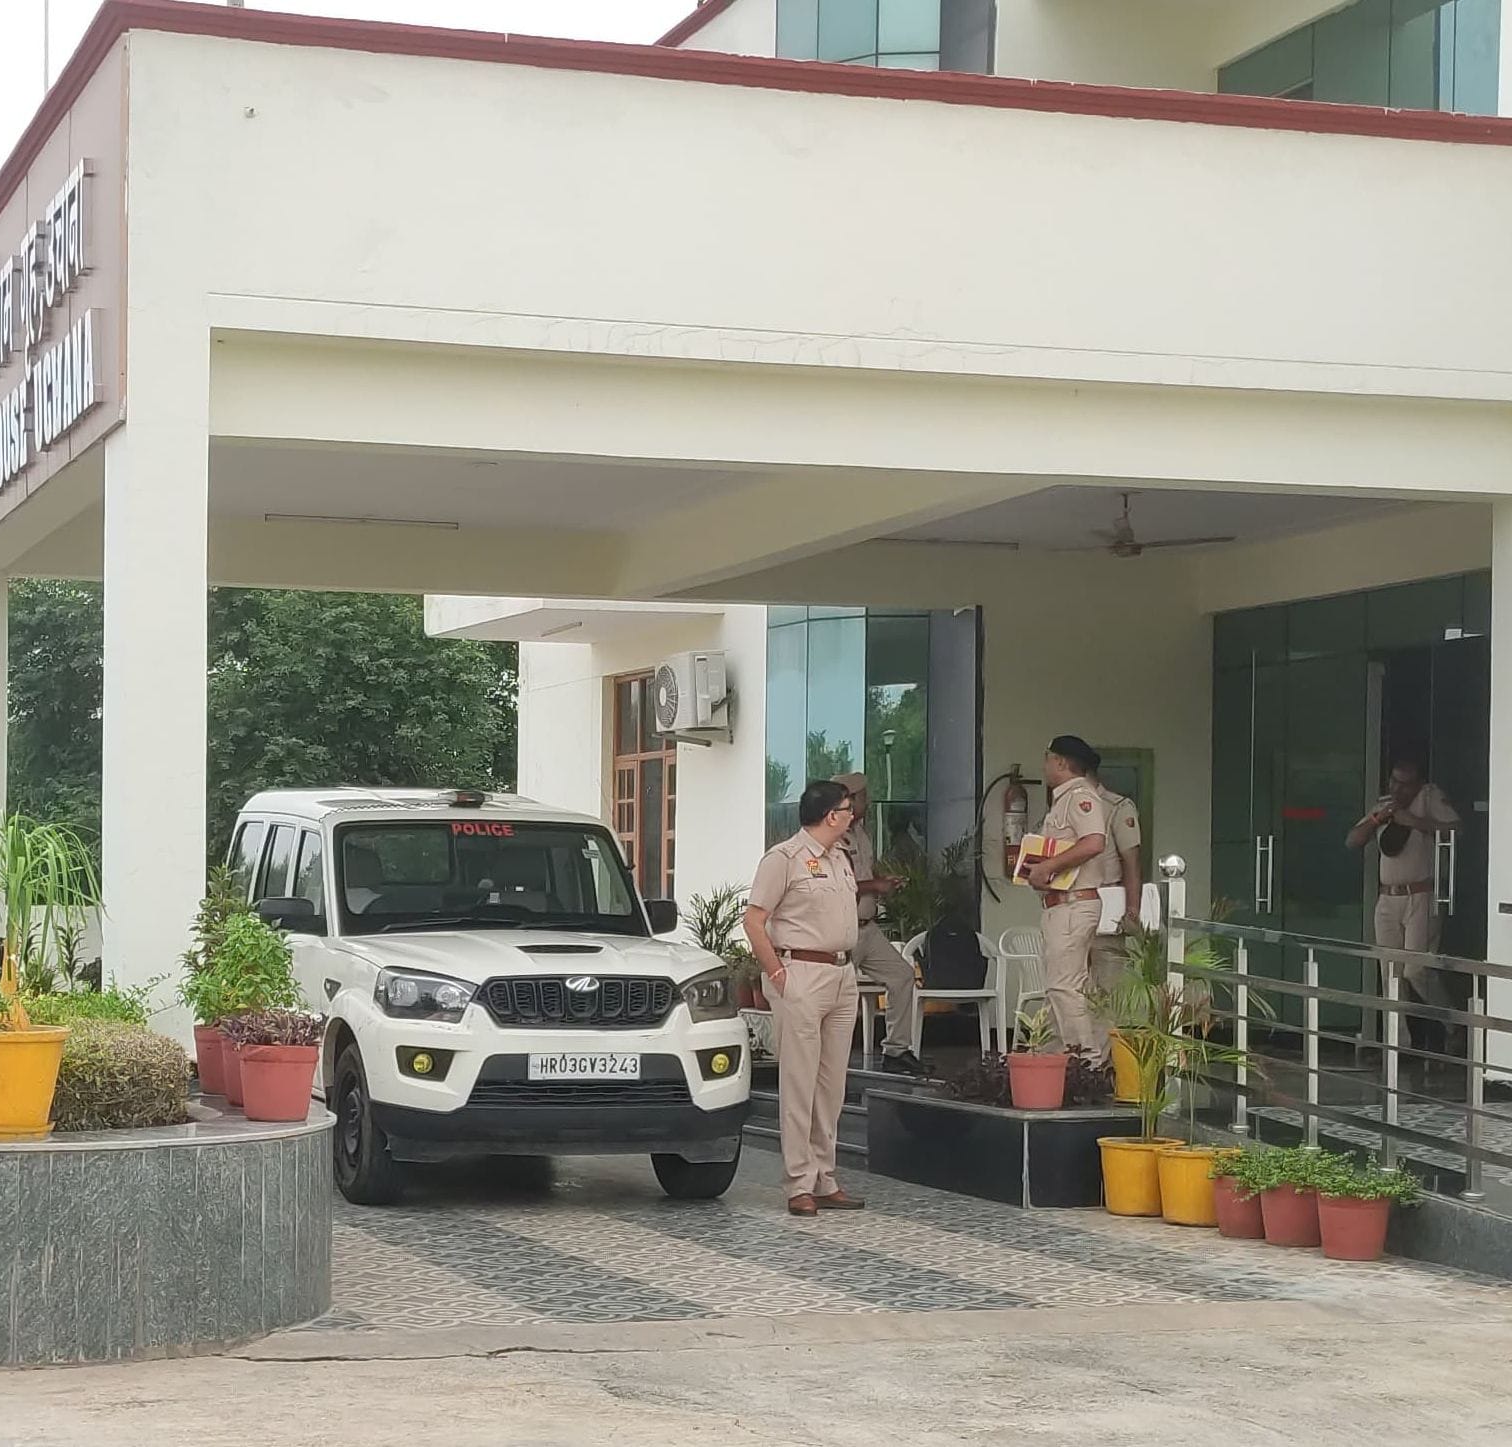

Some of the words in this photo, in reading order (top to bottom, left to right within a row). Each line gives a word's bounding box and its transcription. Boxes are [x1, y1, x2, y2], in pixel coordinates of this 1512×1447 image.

[45, 157, 84, 308] उचाना
[33, 308, 94, 453] UCHANA
[451, 822, 515, 837] POLICE
[540, 1056, 638, 1074] HR03GV3243
